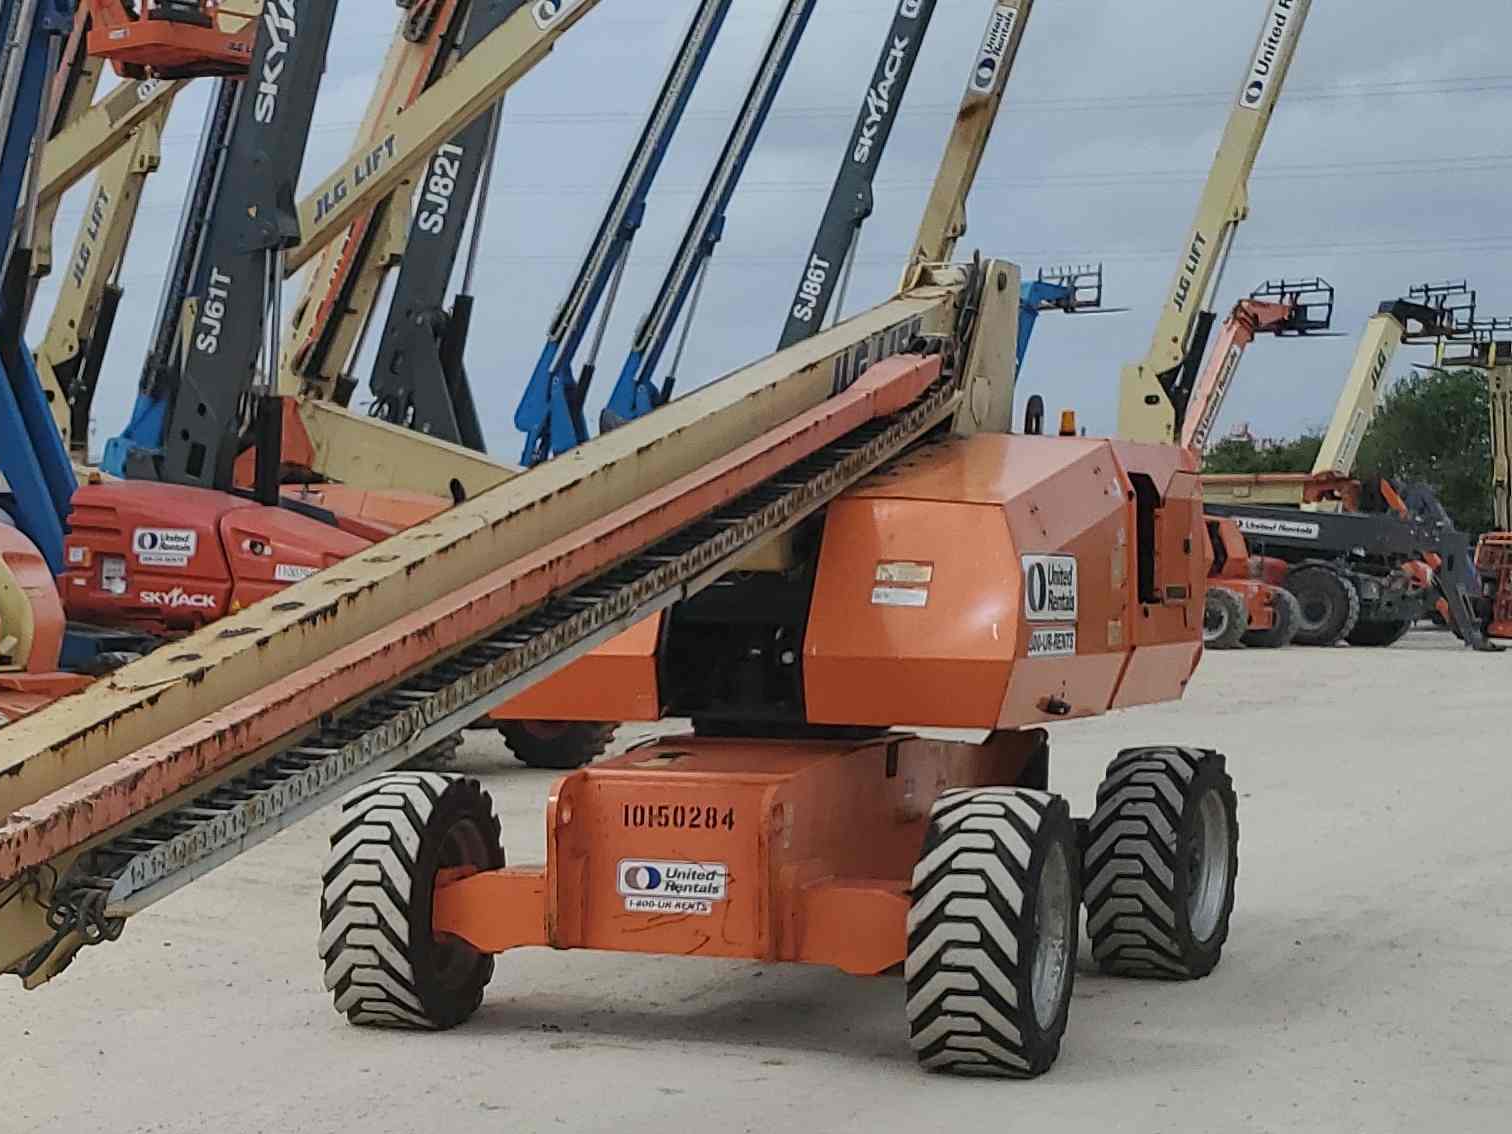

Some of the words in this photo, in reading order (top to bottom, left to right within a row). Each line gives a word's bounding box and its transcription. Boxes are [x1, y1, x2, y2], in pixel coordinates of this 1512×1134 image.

[1255, 13, 1287, 76] United
[853, 36, 909, 164] SKYJACK
[314, 178, 347, 224] JLG
[353, 134, 398, 186] LIFT
[73, 243, 91, 289] JLG
[88, 185, 109, 242] LIFT
[793, 253, 831, 322] SJ86T
[1173, 275, 1191, 312] JLG
[1186, 232, 1207, 275] LIFT
[196, 266, 233, 354] SJ61T
[1371, 348, 1388, 389] JLG
[139, 585, 216, 608] SKYJACK
[1048, 562, 1074, 586] United
[1048, 590, 1075, 612] Rentals
[624, 803, 735, 831] 10150284
[664, 879, 720, 895] Rentals
[665, 866, 717, 881] United
